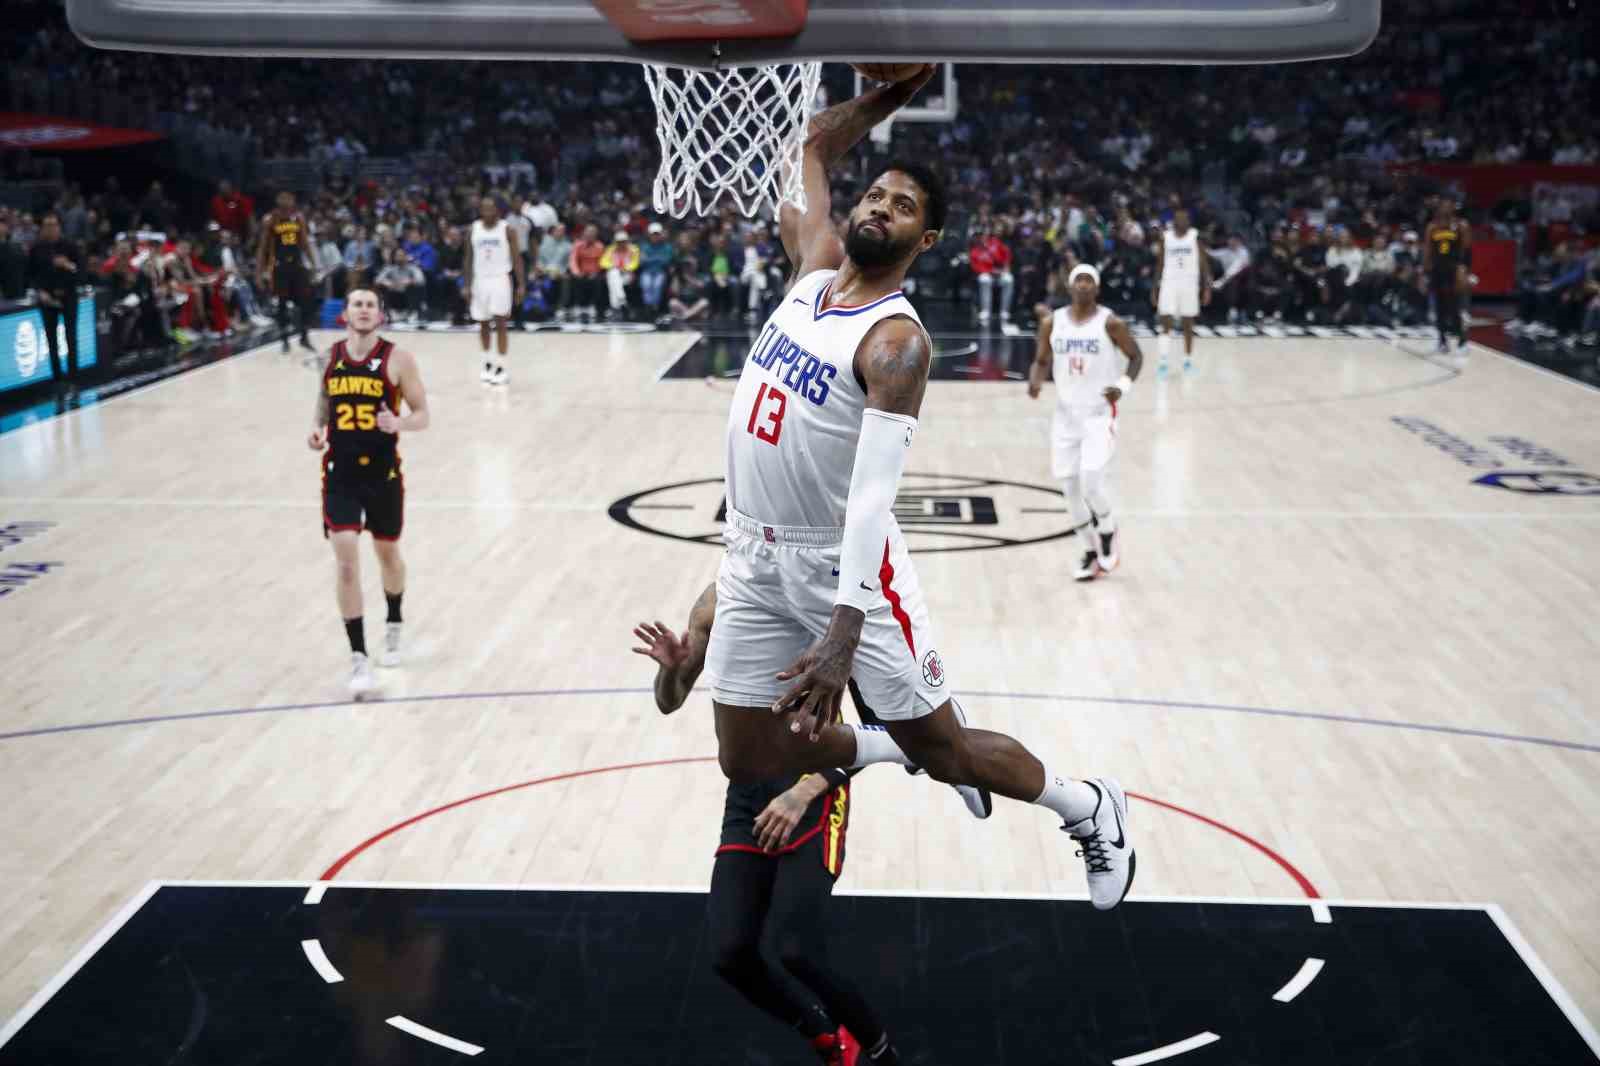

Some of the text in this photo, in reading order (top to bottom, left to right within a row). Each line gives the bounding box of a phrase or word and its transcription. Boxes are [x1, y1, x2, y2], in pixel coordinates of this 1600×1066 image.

[327, 375, 385, 398] HAWKS
[752, 322, 837, 406] CLIPPERS
[335, 402, 377, 431] 25
[747, 382, 787, 447] 13
